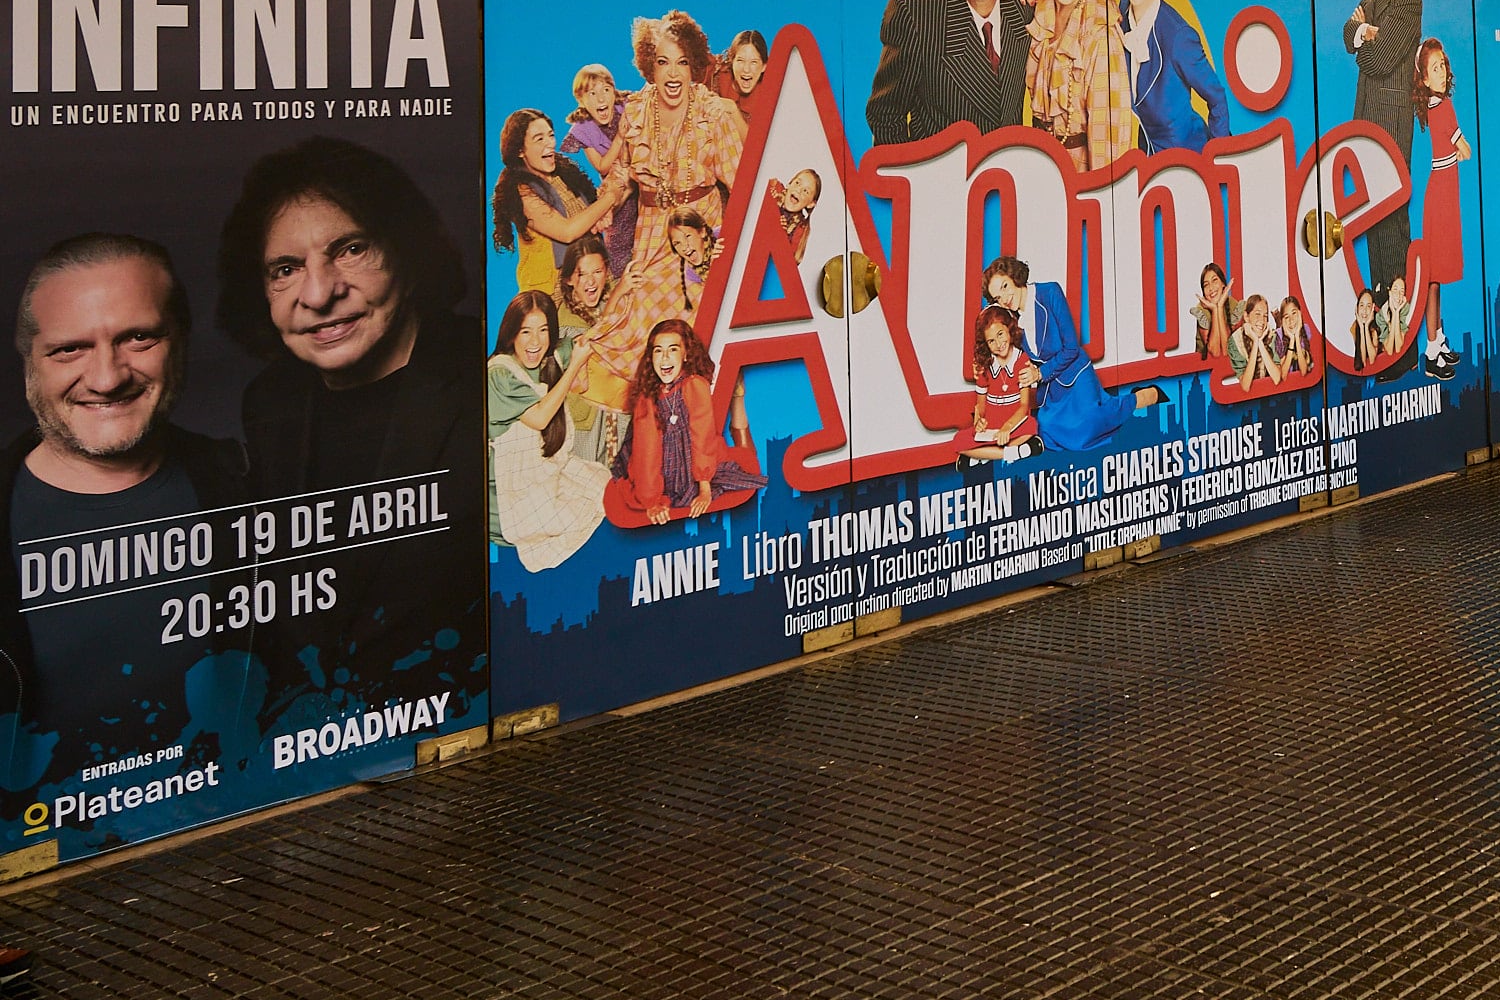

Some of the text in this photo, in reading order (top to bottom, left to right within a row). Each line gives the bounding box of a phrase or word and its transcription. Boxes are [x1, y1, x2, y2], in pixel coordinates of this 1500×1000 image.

[10, 98, 453, 127] UN ENCUENTRO PARA TODOS Y PARA NADIE
[605, 24, 1430, 525] Annie
[21, 481, 448, 600] DOMINGO 19 DE ABRIL
[632, 384, 1442, 608] ANNIE Libro THOMAS MEEHAN Música CHARLES STROUSE Letras MARTIN CHARNIN
[783, 439, 1357, 610] Versión y Traducción de FERNANDO MASLLORENS y FEDERICO GONZÁLEZ DEL PINO
[784, 605, 828, 637] Original
[892, 577, 934, 607] directed
[936, 576, 949, 598] by
[951, 563, 991, 592] MARTIN
[993, 550, 1040, 581] CHARNIN
[1041, 545, 1069, 568] Based
[1071, 542, 1083, 558] on
[1084, 529, 1117, 553] "LITTLE
[1117, 519, 1154, 546] ORPHAN
[1155, 511, 1186, 535] ANNIE"
[1186, 510, 1197, 530] by
[1197, 499, 1240, 527] permission
[1240, 494, 1249, 513] of
[1249, 482, 1282, 510] TRIBUNE
[1282, 476, 1314, 500] CONTENT
[1345, 467, 1358, 486] LLC
[161, 566, 337, 645] 20:30 HS
[82, 744, 183, 782] ENTRADAS POR
[273, 692, 451, 770] BROADWAY
[54, 761, 219, 829] Plateanet
